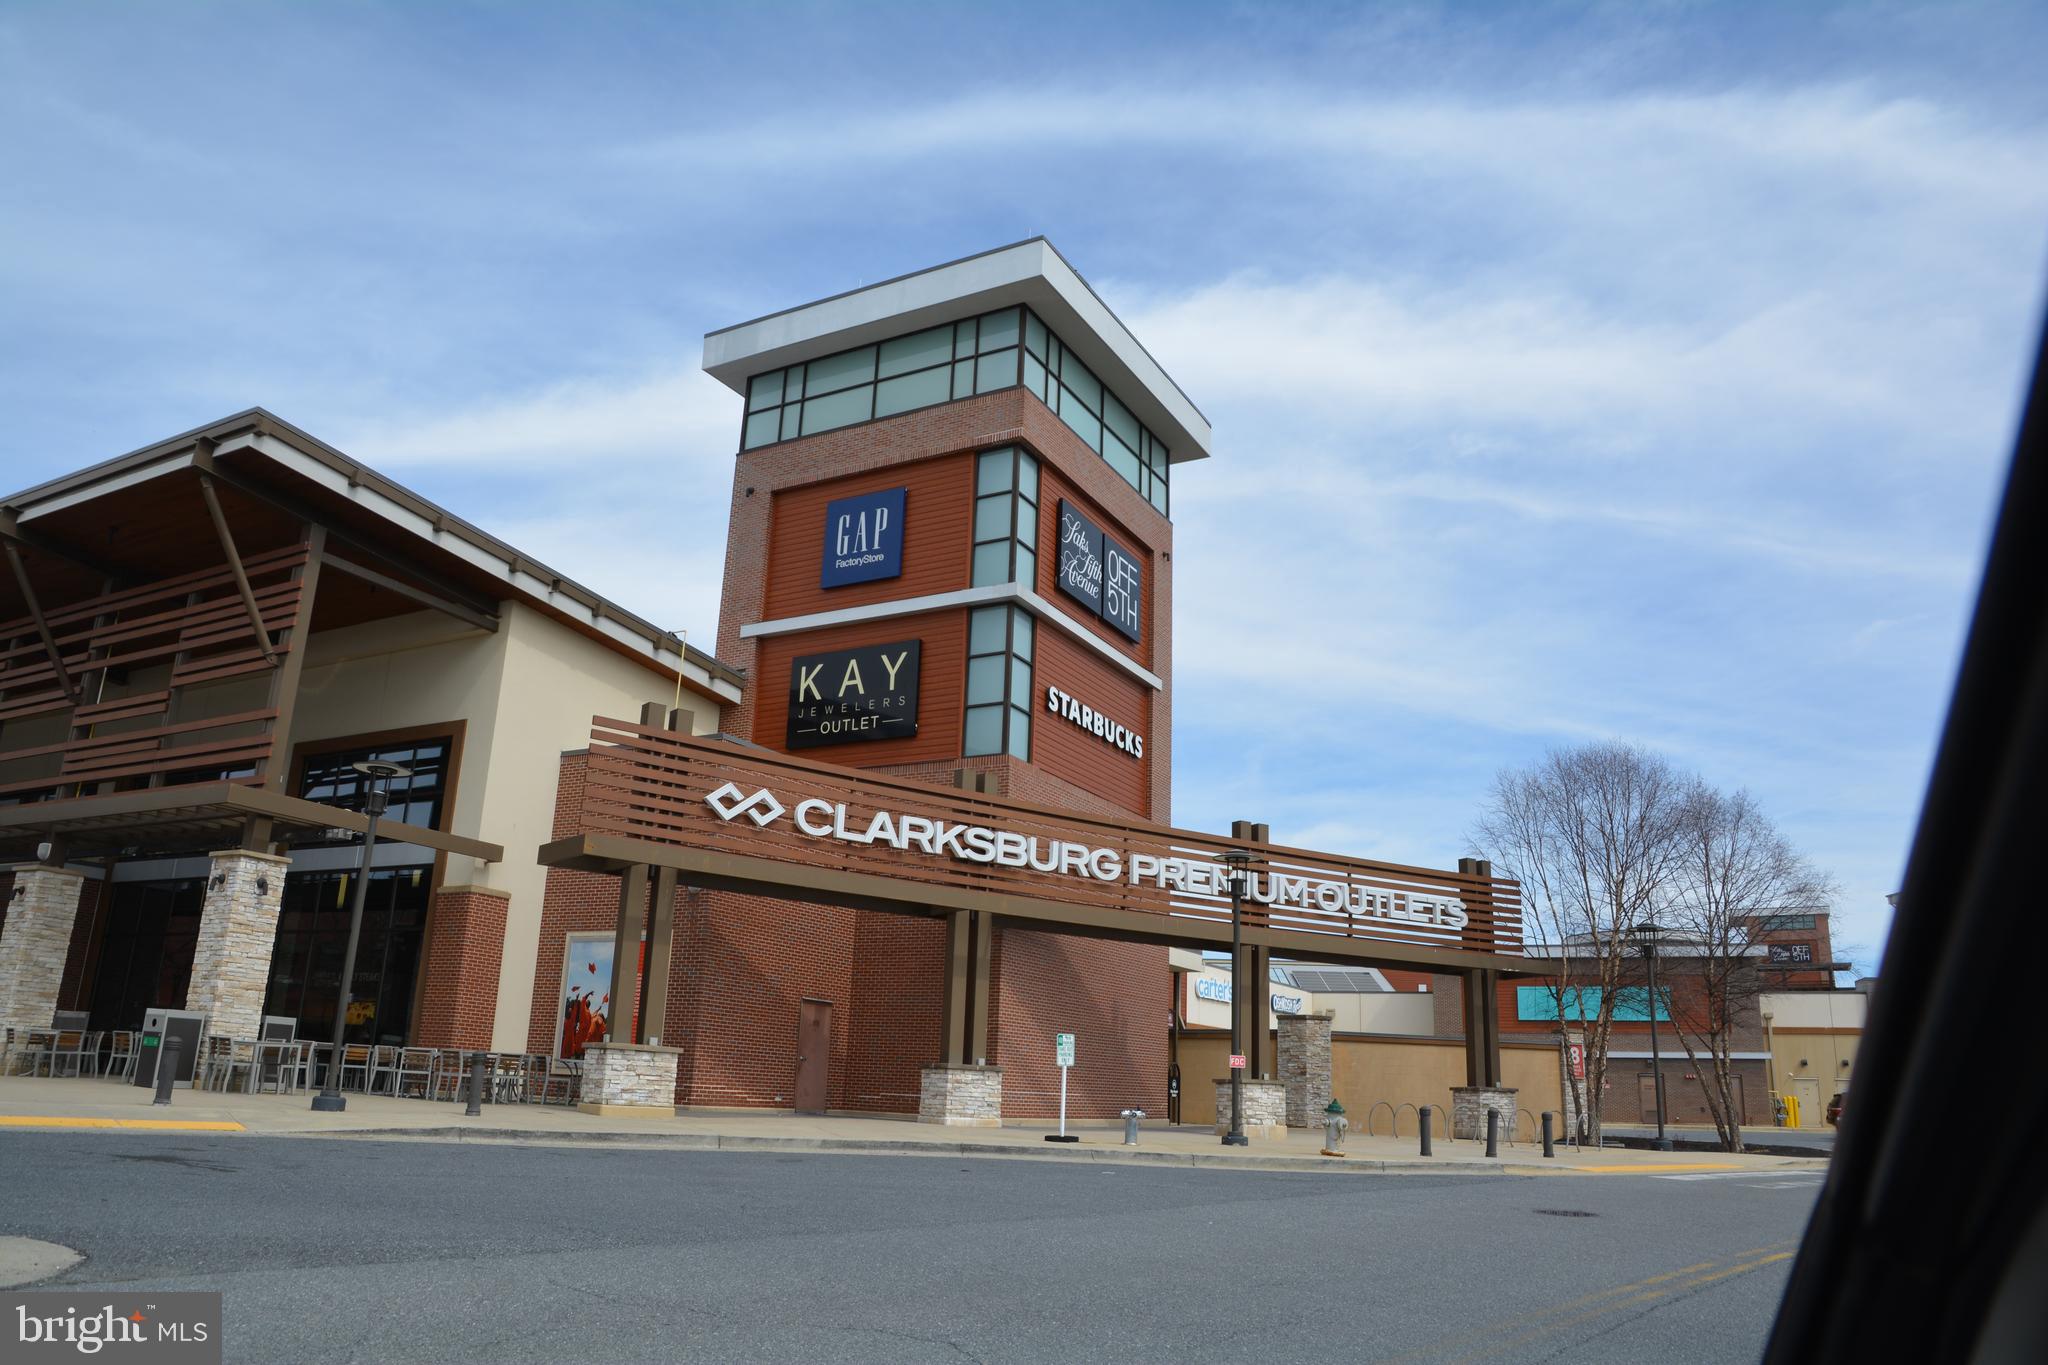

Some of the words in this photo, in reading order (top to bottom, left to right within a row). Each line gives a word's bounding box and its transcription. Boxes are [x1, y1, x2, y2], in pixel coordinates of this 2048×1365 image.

[836, 507, 888, 557] GAP
[1061, 513, 1089, 554] Saks
[1060, 550, 1099, 599] Avenue
[1108, 550, 1138, 593] OFF
[1108, 580, 1138, 632] 5TH
[799, 651, 908, 703] KAY
[798, 695, 906, 718] JEWELERS
[820, 715, 880, 734] OUTLET
[1048, 685, 1143, 759] STARBUCKS
[794, 798, 1122, 881] CLARKSBURG
[1129, 854, 1309, 908] PREMIUM
[1314, 882, 1470, 928] OUTLETS
[1231, 1057, 1245, 1066] FDC
